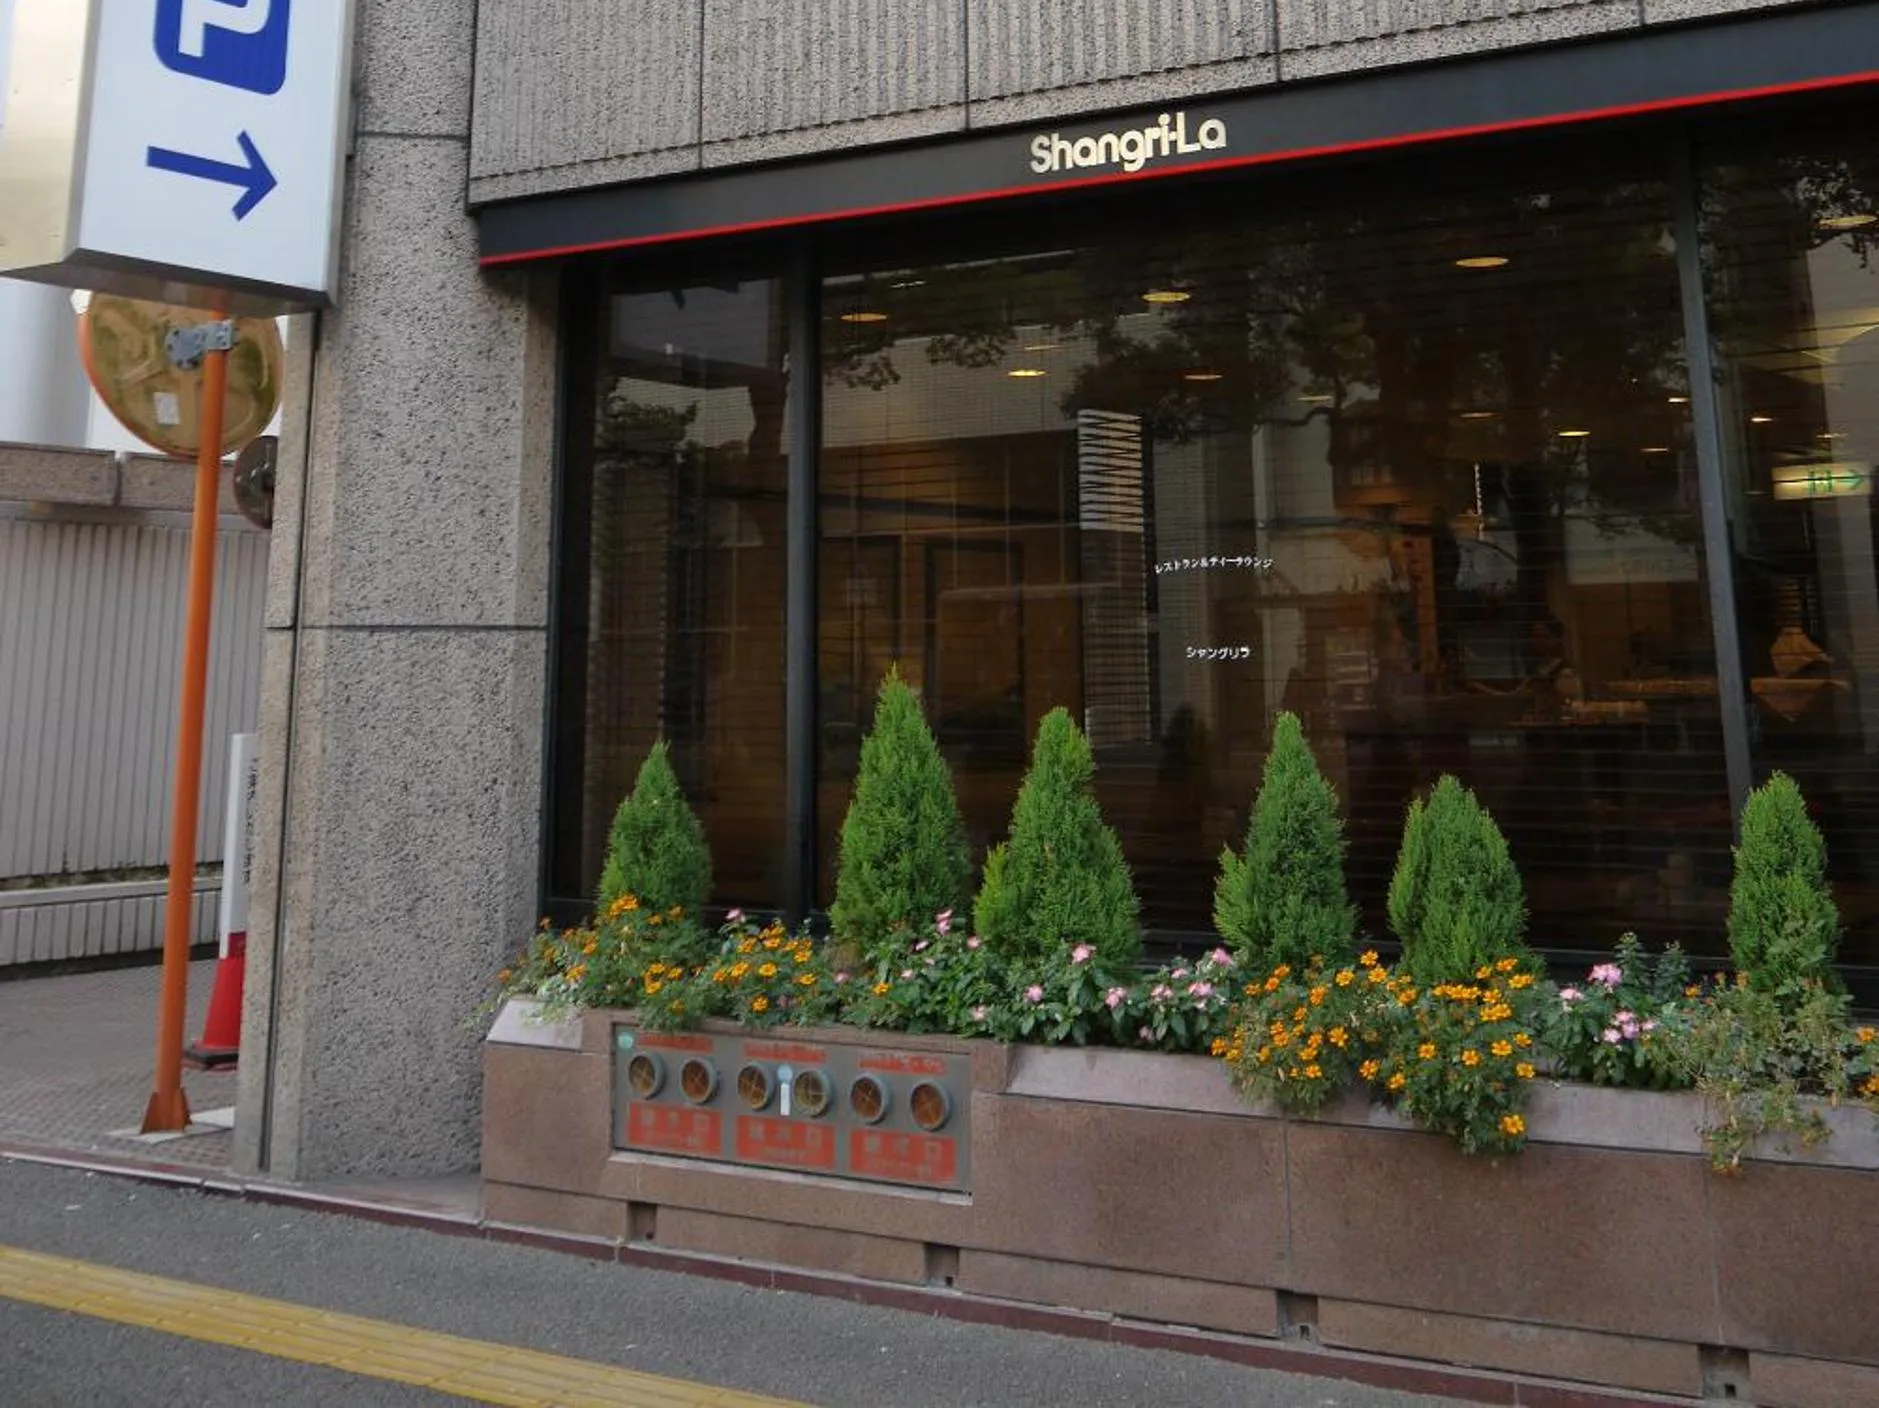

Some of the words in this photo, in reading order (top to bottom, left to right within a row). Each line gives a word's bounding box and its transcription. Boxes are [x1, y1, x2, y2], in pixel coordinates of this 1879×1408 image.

[1030, 111, 1226, 173] Shangri-La
[1185, 645, 1252, 660] シャングリラ
